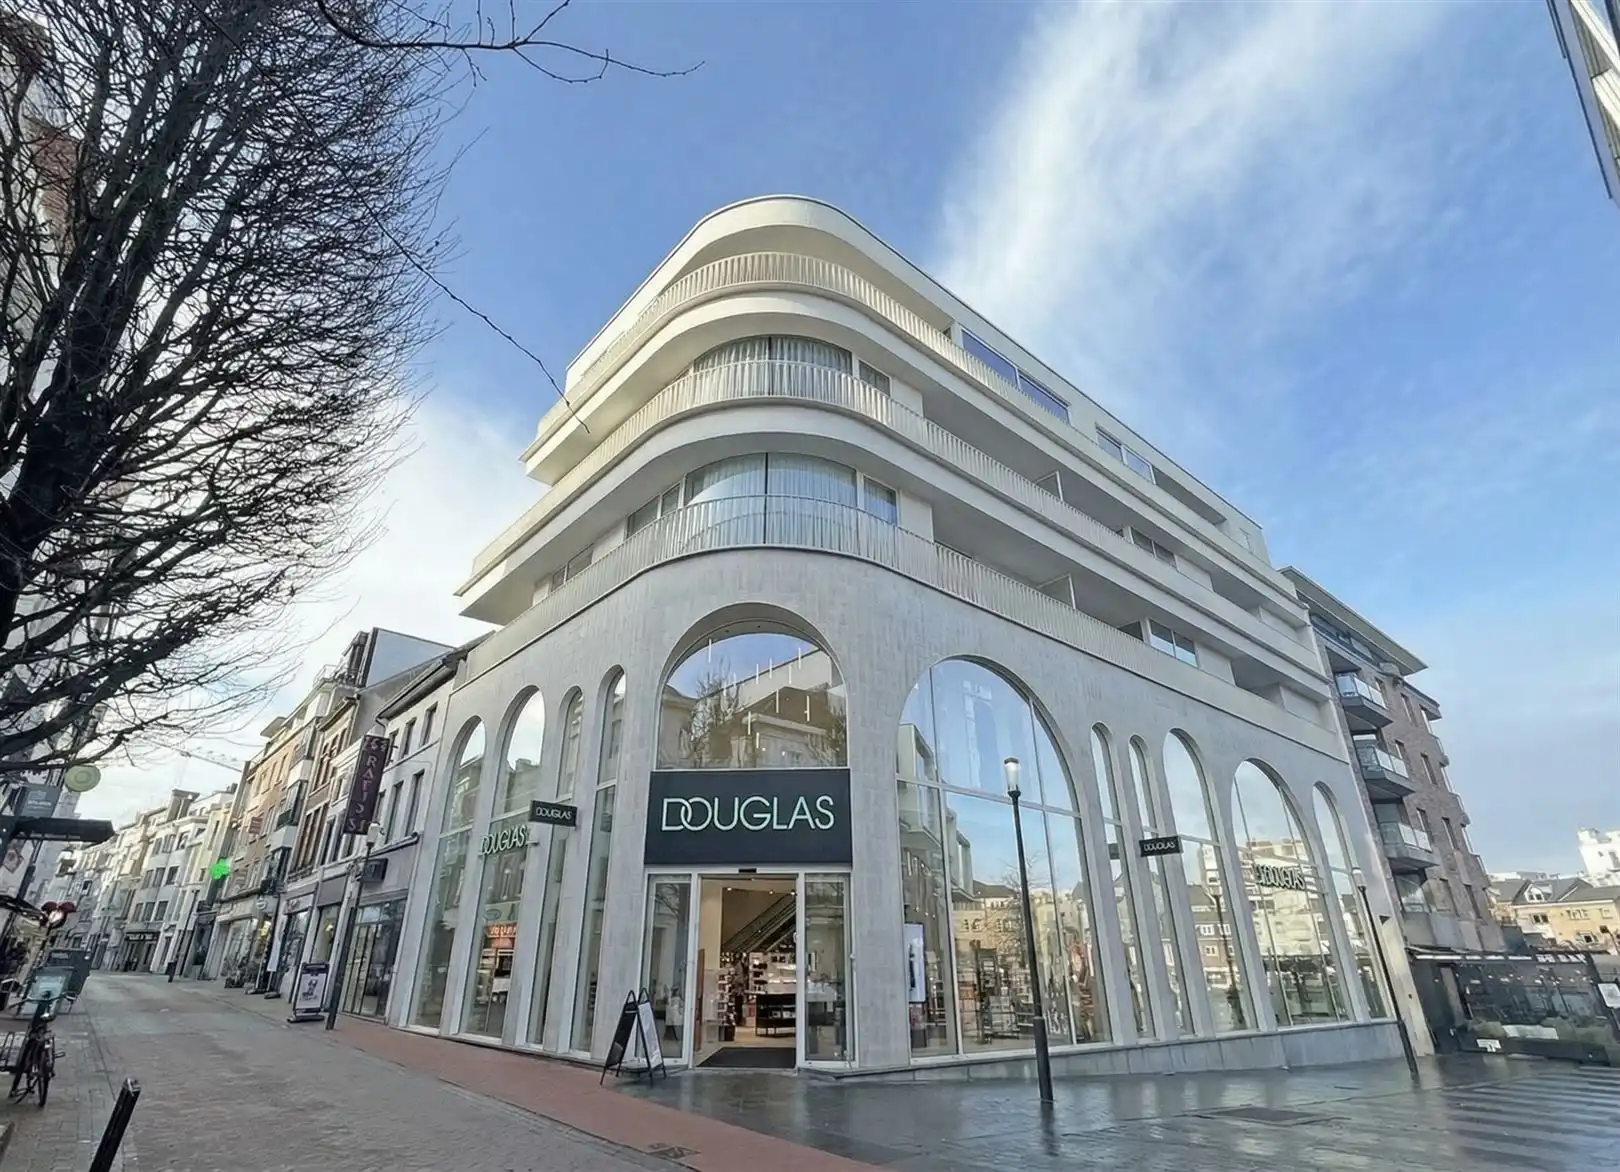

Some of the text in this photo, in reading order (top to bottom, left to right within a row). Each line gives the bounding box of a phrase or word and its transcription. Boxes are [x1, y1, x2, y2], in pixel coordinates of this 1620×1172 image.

[536, 806, 573, 821] DOUGLAS
[661, 795, 835, 831] DOUGLAS
[481, 824, 527, 855] DOUGLAS
[1257, 864, 1306, 890] DOUGLAS
